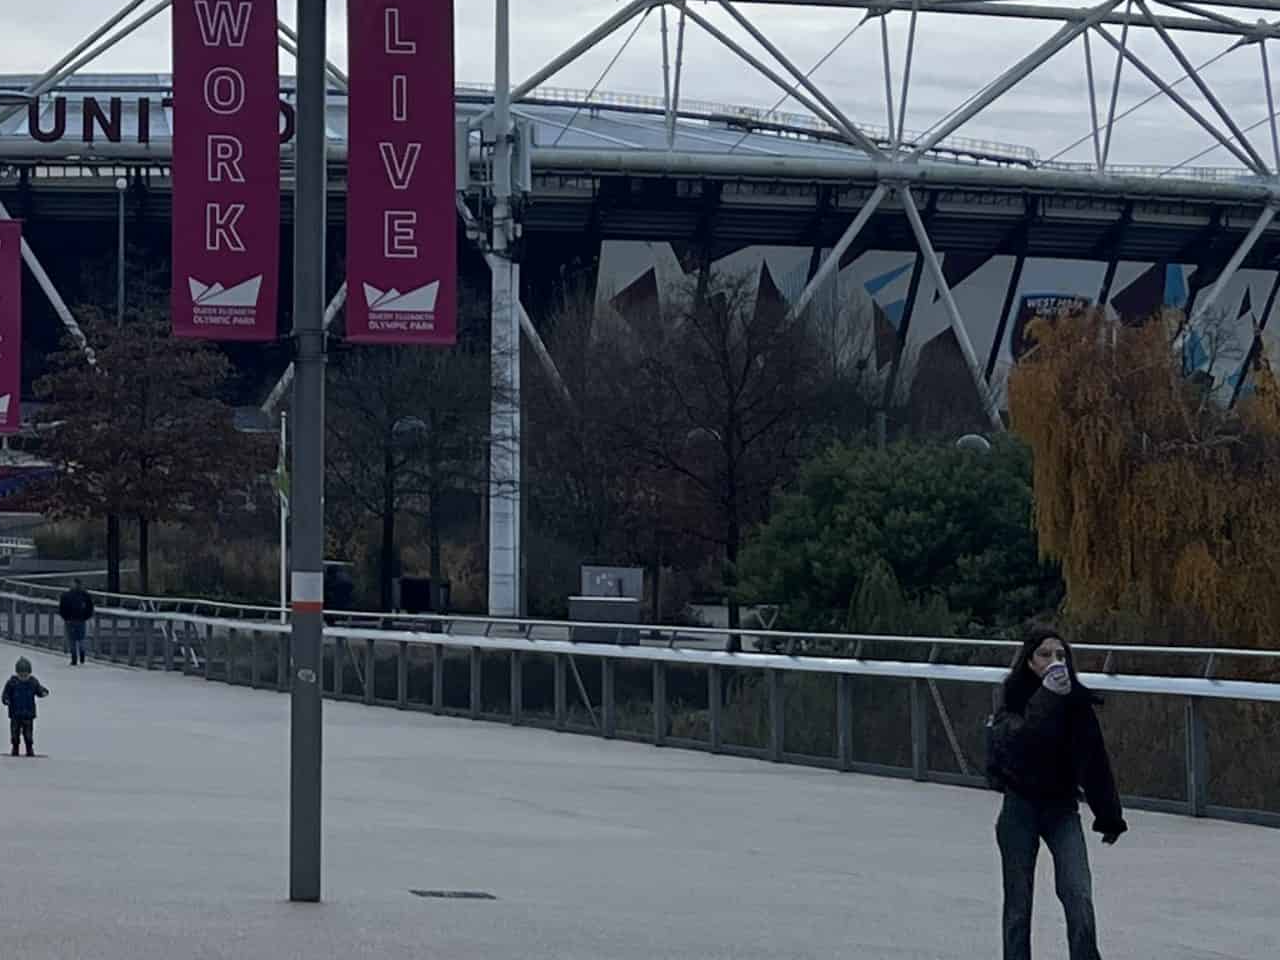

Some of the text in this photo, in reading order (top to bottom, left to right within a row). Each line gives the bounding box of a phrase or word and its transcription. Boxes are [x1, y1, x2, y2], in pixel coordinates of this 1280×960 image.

[28, 96, 295, 143] UNI
[194, 0, 252, 251] WORK
[379, 8, 422, 259] LIVE
[193, 315, 256, 325] OLYMPIC PARK
[368, 320, 435, 331] OLYMPIC PARK
